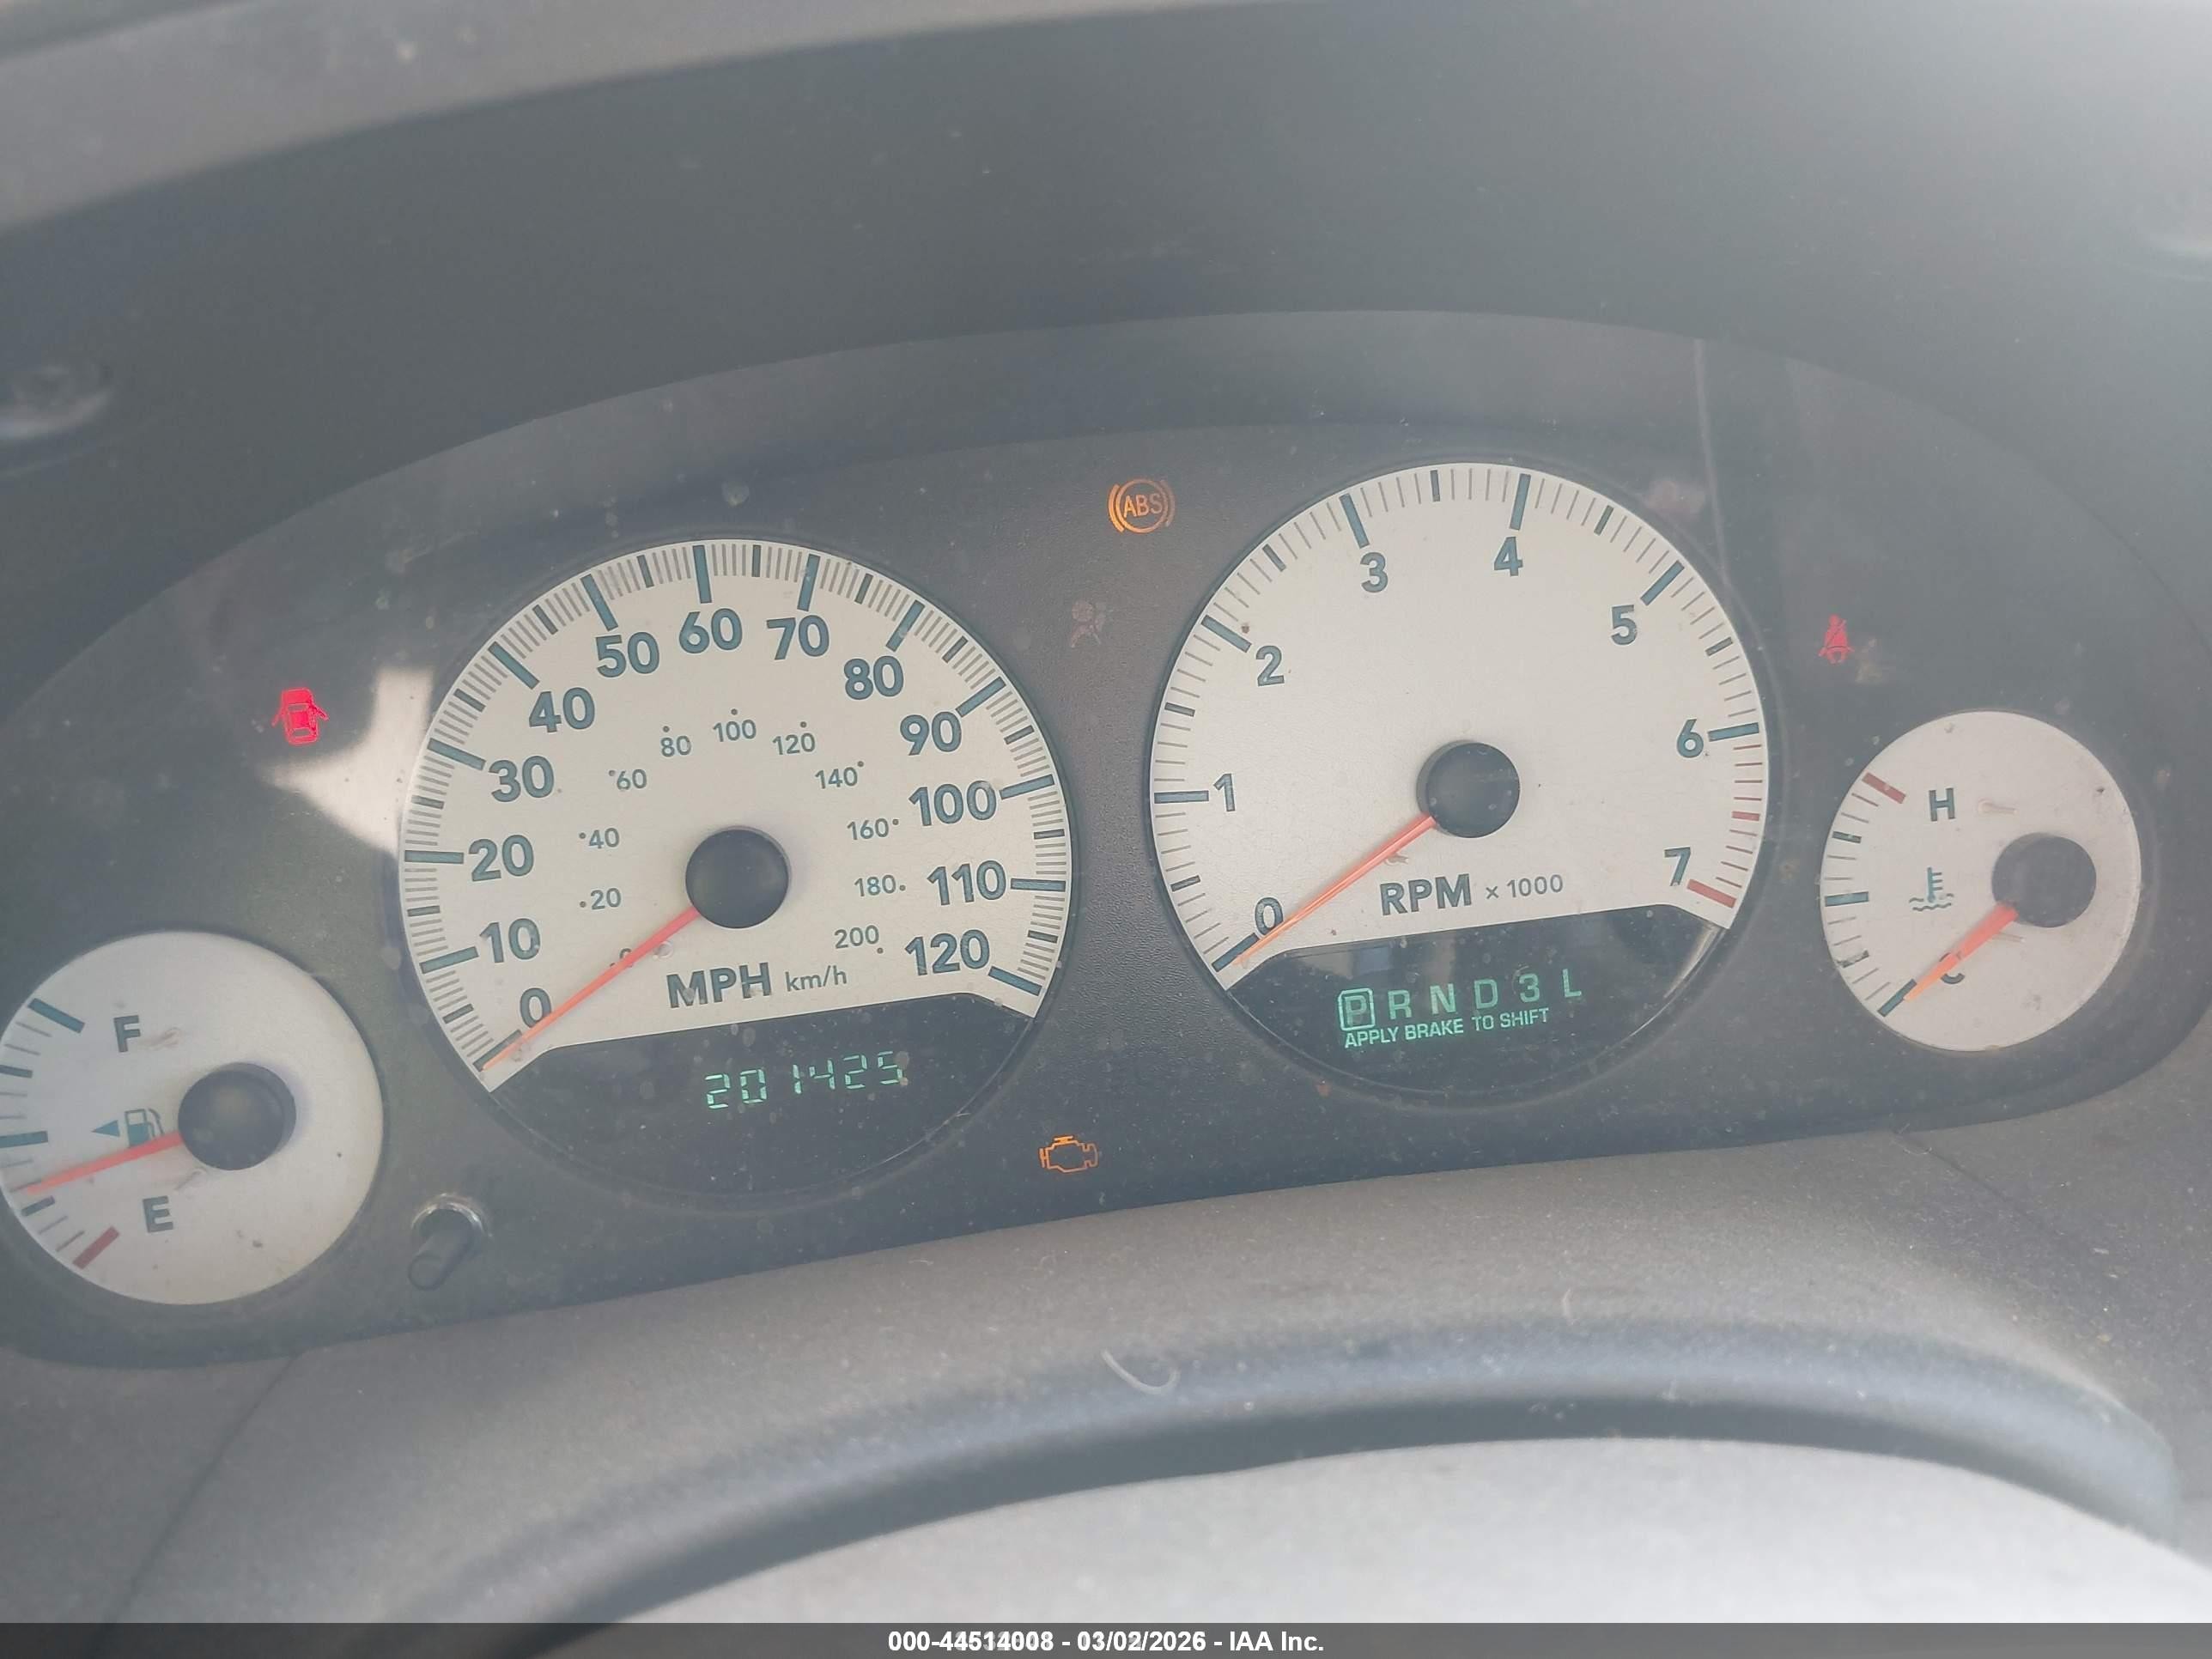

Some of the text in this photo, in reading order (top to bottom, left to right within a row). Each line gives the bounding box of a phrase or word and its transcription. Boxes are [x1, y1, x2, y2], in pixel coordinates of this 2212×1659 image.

[1123, 493, 1163, 518] ABS
[1360, 552, 1389, 592] 3
[1493, 536, 1523, 576] 4
[679, 608, 743, 654] 60
[767, 615, 830, 660] 70
[1610, 605, 1638, 644] 5
[597, 632, 659, 678] 50
[1256, 645, 1285, 686] 2
[843, 655, 904, 700] 80
[528, 687, 595, 732] 40
[660, 735, 691, 757] 80
[712, 720, 756, 741] 100
[773, 732, 816, 755] 120
[899, 711, 962, 756] 90
[1676, 719, 1704, 758] 6
[489, 756, 554, 802] 30
[615, 769, 647, 790] 60
[815, 767, 858, 790] 140
[1213, 773, 1237, 811] 1
[908, 780, 996, 827] 100
[1929, 787, 1955, 821] H
[588, 828, 620, 850] 40
[847, 817, 890, 841] 160
[468, 836, 534, 882] 20
[1664, 847, 1692, 887] 7
[590, 888, 622, 909] 20
[854, 874, 896, 896] 180
[927, 860, 1006, 907] 110
[1379, 874, 1473, 916] RPM
[1506, 874, 1564, 898] 1000
[834, 926, 880, 948] 200
[1255, 897, 1284, 937] 0
[479, 917, 540, 963] 10
[905, 930, 990, 976] 120
[666, 963, 848, 1009] MPH km/h
[1345, 969, 1582, 1025] P R N D 3 L
[520, 988, 551, 1027] 0
[113, 1015, 141, 1053] F
[1345, 1008, 1549, 1048] APPLY BRAKE TO SHIFT
[143, 1195, 173, 1233] E
